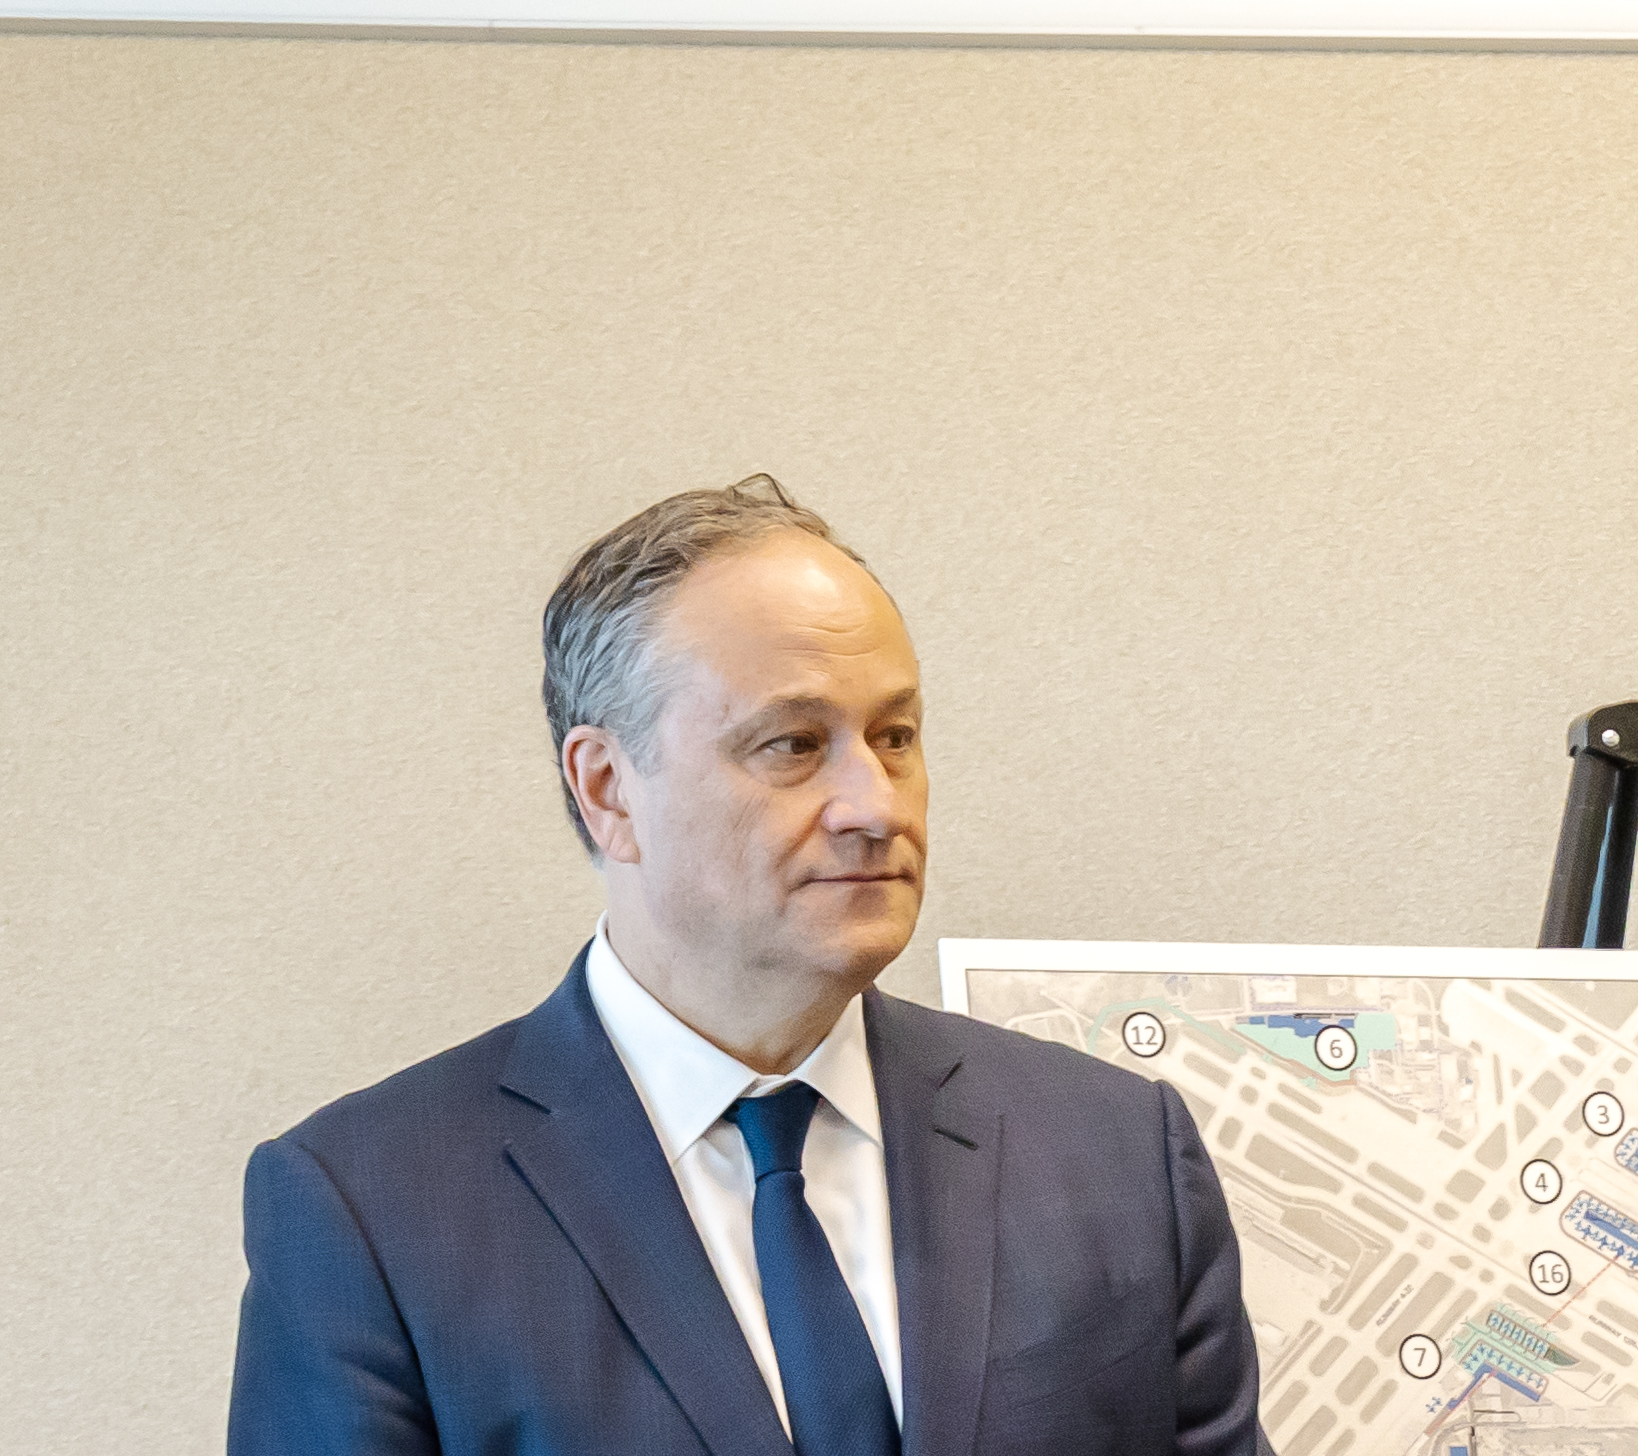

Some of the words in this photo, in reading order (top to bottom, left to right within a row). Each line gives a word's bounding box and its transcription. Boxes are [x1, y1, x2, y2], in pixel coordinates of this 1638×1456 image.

[1131, 1025, 1159, 1046] 12
[1329, 1039, 1343, 1059] 6
[1597, 1104, 1610, 1125] 3
[1534, 1172, 1549, 1193] 4
[1537, 1263, 1564, 1284] 16
[1413, 1347, 1427, 1368] 7
